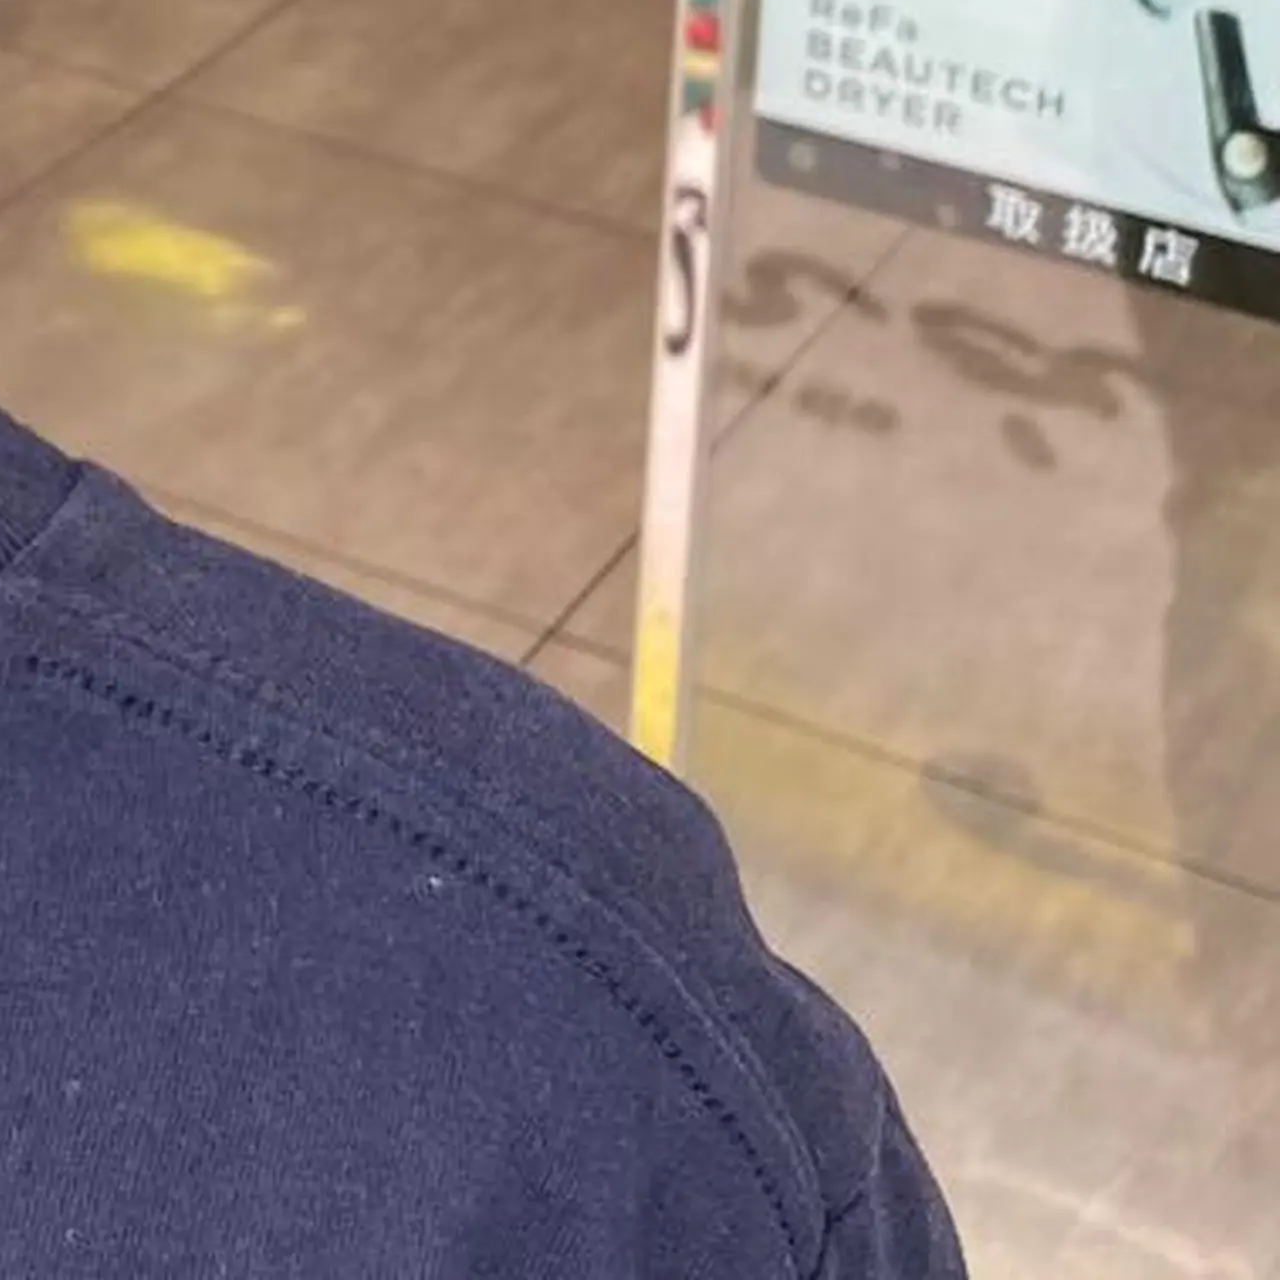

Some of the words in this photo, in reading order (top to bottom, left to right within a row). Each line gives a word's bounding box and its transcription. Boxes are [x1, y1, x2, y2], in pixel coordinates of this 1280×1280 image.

[804, 67, 962, 136] DRYER
[806, 28, 1065, 117] BEAUTECH
[984, 183, 1200, 287] 取扱店
